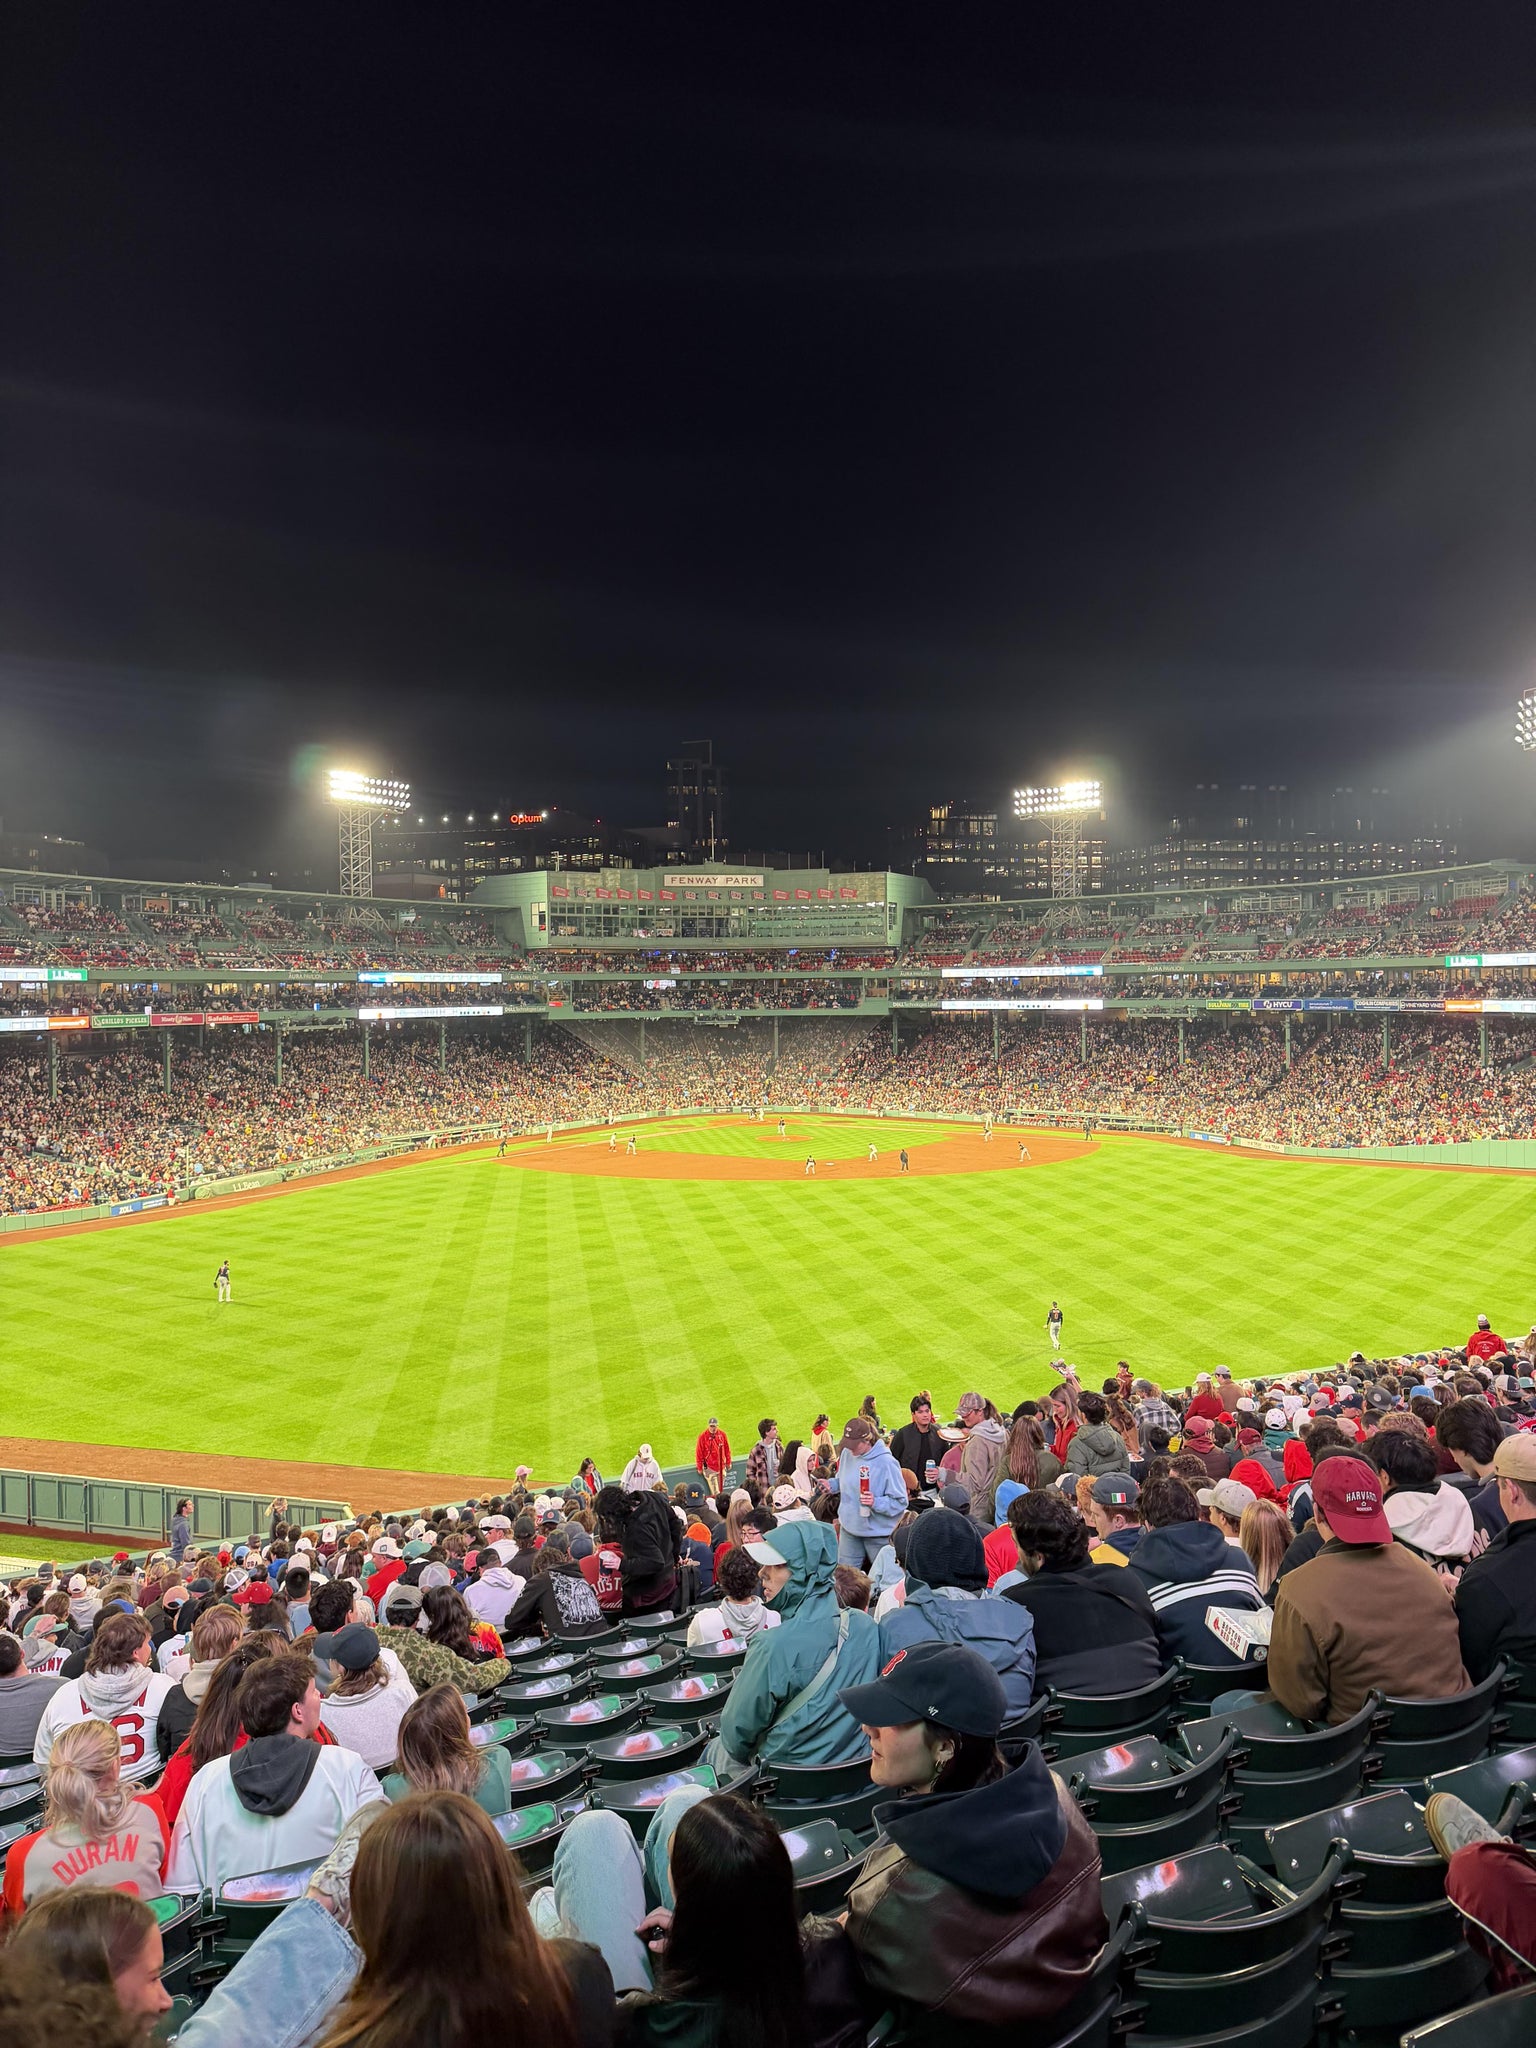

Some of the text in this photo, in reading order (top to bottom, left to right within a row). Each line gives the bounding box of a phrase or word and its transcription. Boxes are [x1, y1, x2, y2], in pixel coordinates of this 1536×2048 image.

[510, 814, 543, 825] Optum
[670, 876, 758, 885] FENWAY PARK
[207, 1014, 233, 1022] Safelite
[119, 1206, 134, 1214] ZOLL
[1346, 1491, 1377, 1503] HARVARD
[1221, 1620, 1242, 1644] BOSTON
[1219, 1630, 1240, 1652] RED SOX
[52, 1834, 139, 1886] DURAN
